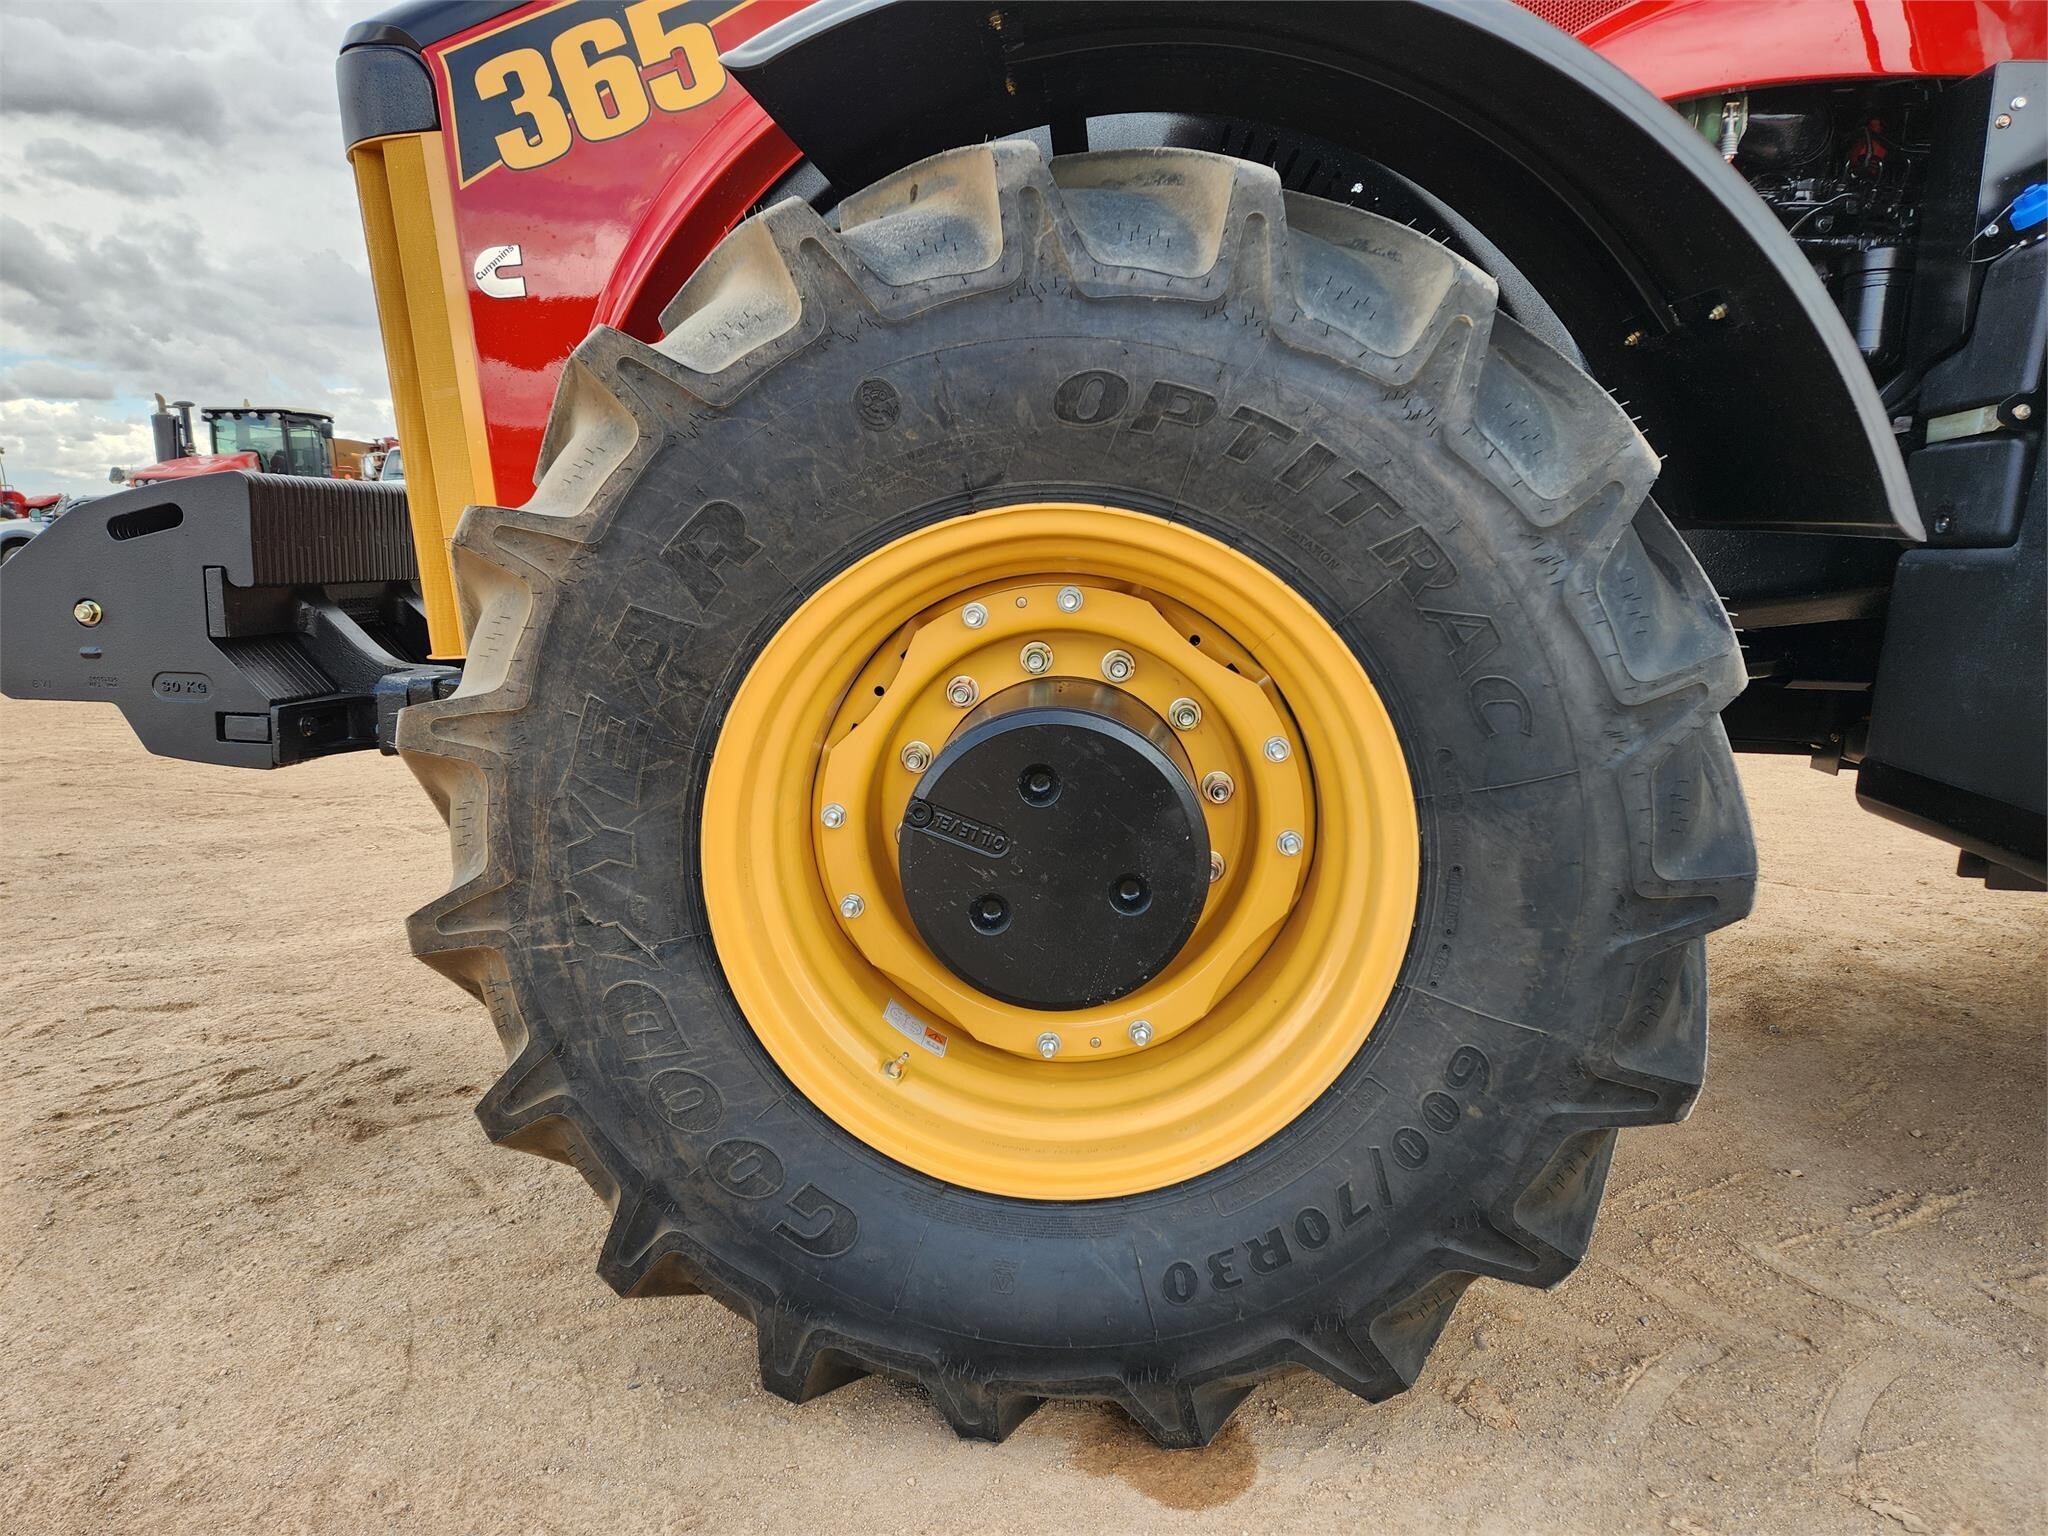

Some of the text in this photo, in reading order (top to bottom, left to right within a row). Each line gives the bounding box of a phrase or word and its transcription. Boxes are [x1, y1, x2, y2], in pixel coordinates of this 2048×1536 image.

[474, 0, 728, 171] 365
[475, 245, 515, 281] Cummins
[1052, 367, 1536, 740] OPTITRAC
[185, 680, 208, 694] KG
[982, 829, 1006, 850] OIL
[1161, 1043, 1494, 1307] 600/70R30
